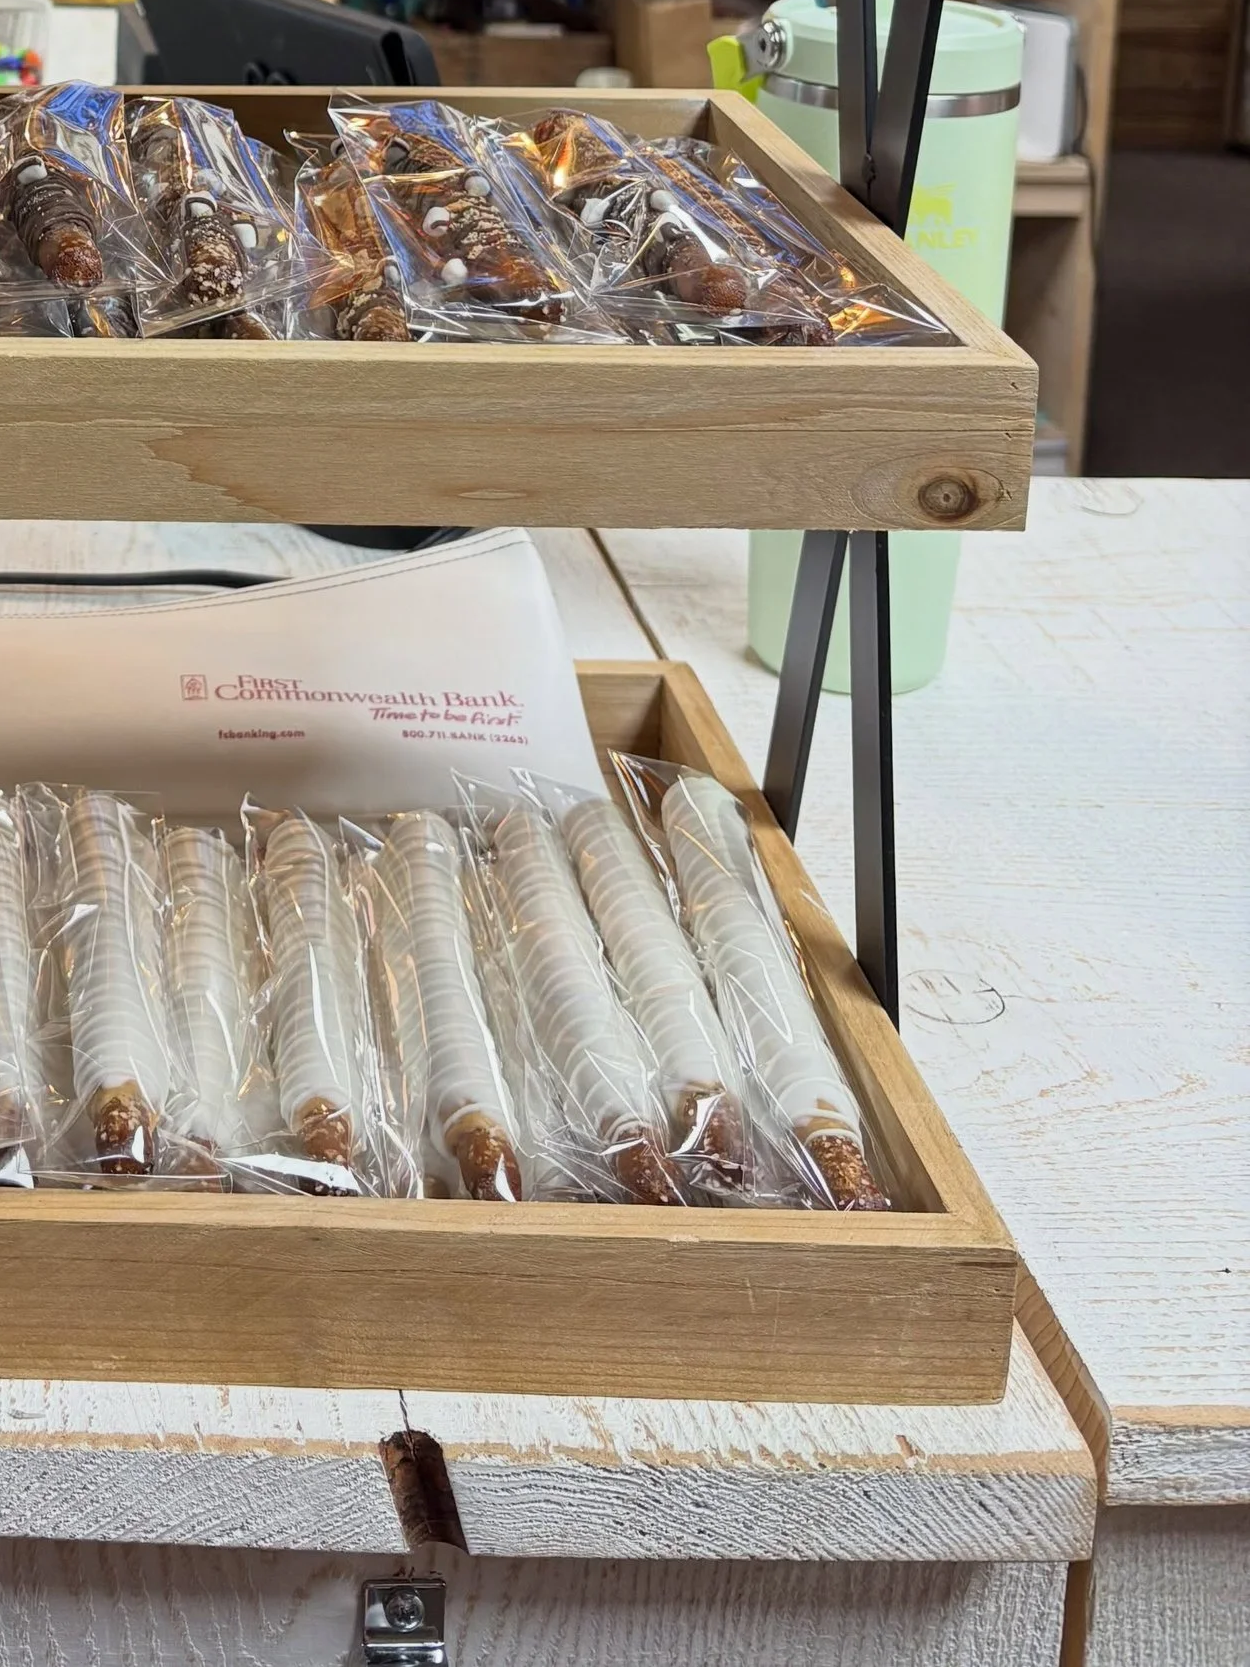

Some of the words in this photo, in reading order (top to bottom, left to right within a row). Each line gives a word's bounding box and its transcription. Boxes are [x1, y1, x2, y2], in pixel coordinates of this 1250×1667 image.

[238, 674, 303, 690] FIRST
[214, 683, 437, 707] Commonwealth
[369, 707, 417, 722] Time
[421, 708, 441, 722] to
[443, 708, 468, 723] be
